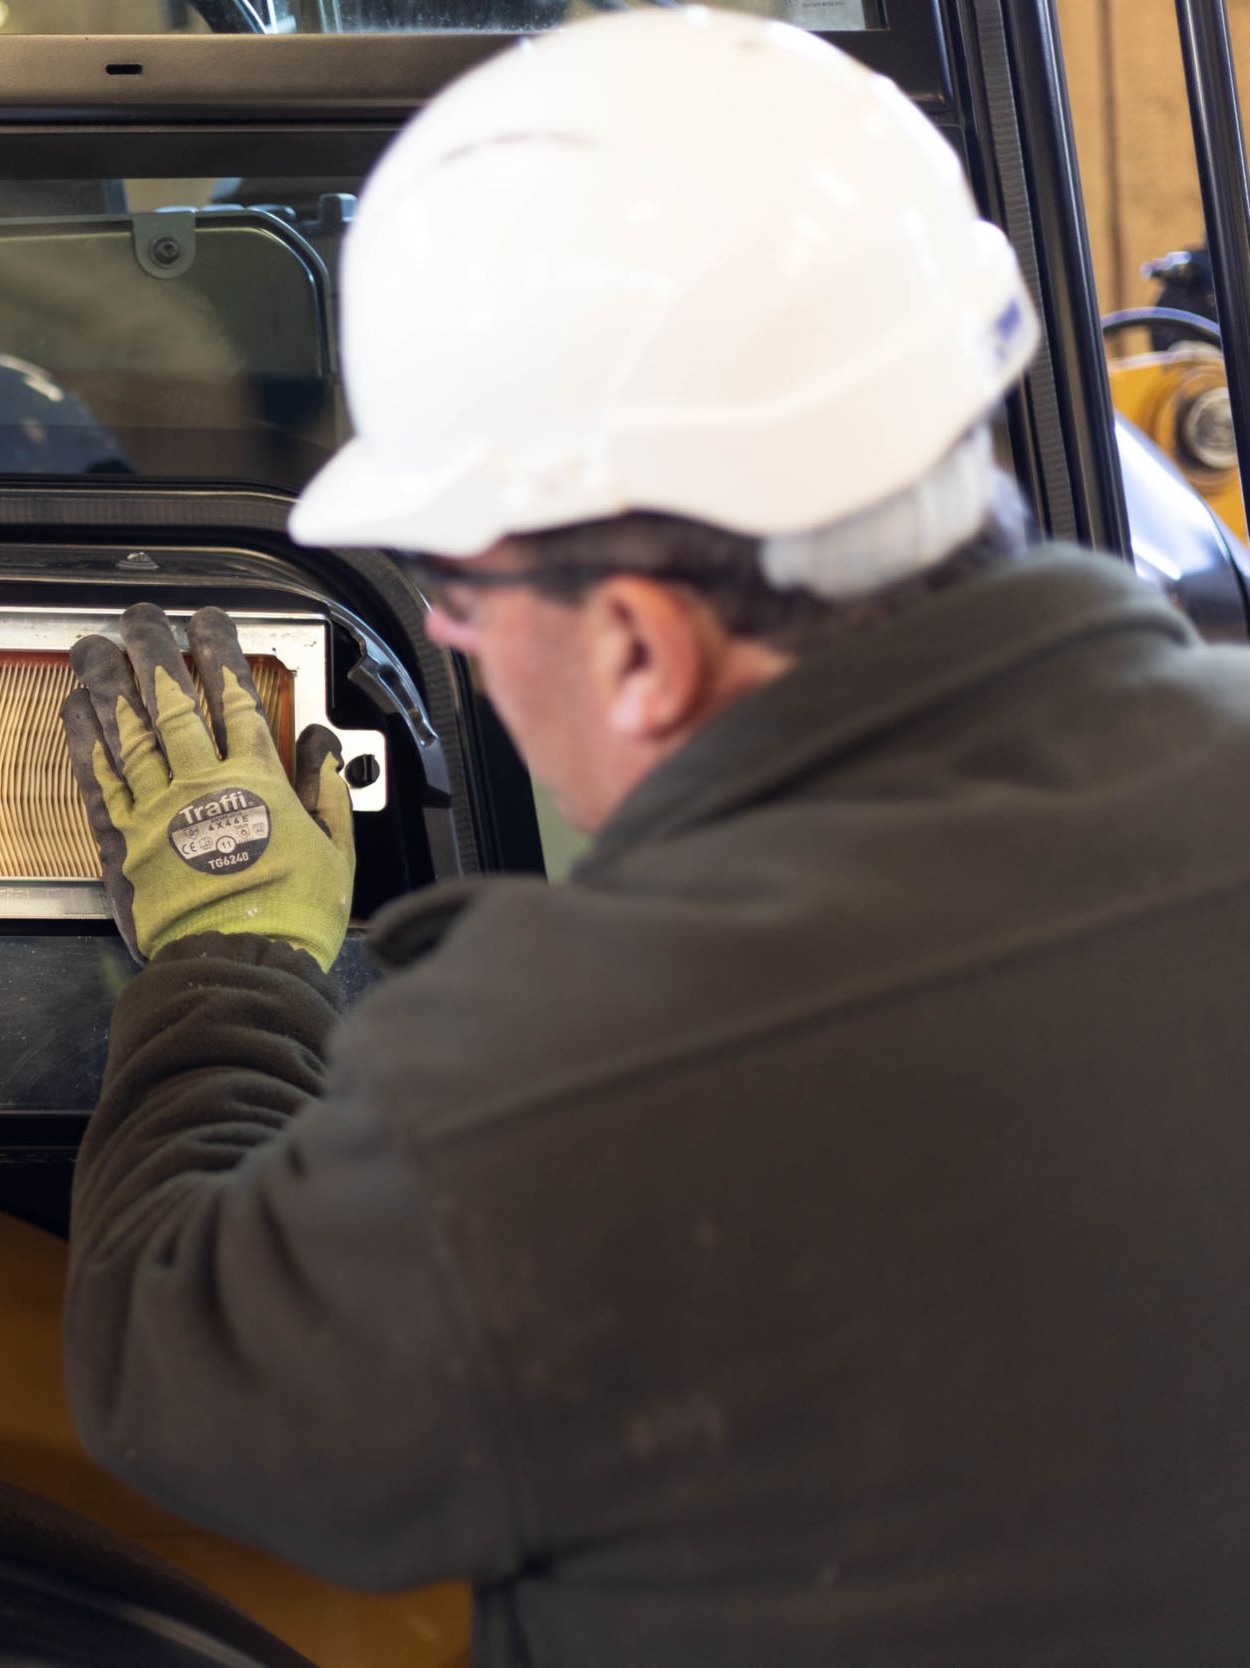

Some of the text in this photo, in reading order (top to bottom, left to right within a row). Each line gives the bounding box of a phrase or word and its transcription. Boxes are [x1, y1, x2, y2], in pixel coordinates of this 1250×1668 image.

[179, 791, 247, 824] Traffi
[182, 841, 197, 855] CE
[208, 851, 249, 870] TG6240
